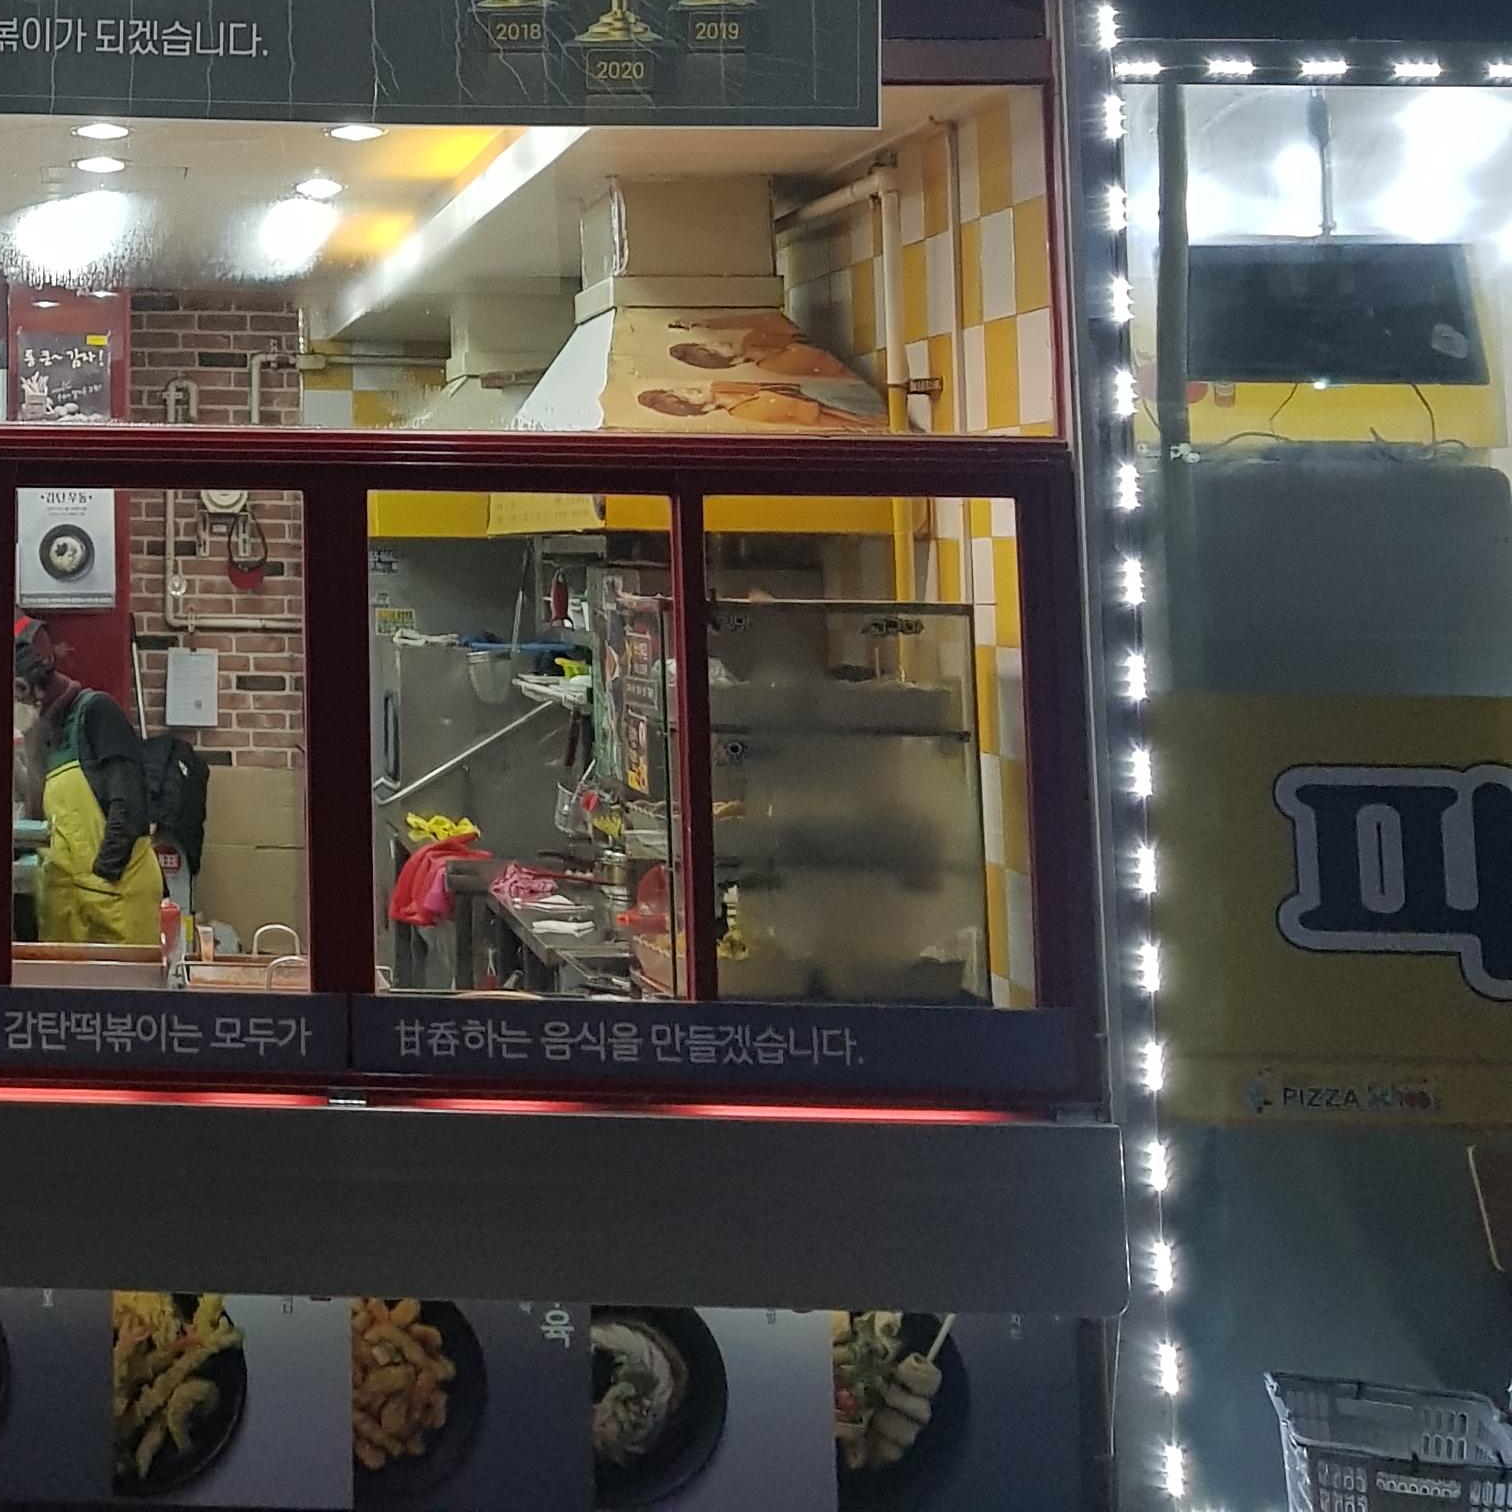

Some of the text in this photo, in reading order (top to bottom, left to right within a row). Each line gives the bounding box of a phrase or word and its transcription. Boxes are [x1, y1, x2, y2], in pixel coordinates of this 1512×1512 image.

[94, 15, 270, 59] 되겠습니다.
[495, 21, 542, 42] 2018
[694, 21, 740, 41] 2019
[596, 60, 646, 81] 2020
[3, 1009, 204, 1056] 감탄떡볶이는
[210, 1015, 313, 1057] 모두가
[539, 1019, 641, 1063] 음식을
[650, 1022, 866, 1067] 만들겠습니다.
[1282, 1086, 1361, 1108] PIZZA
